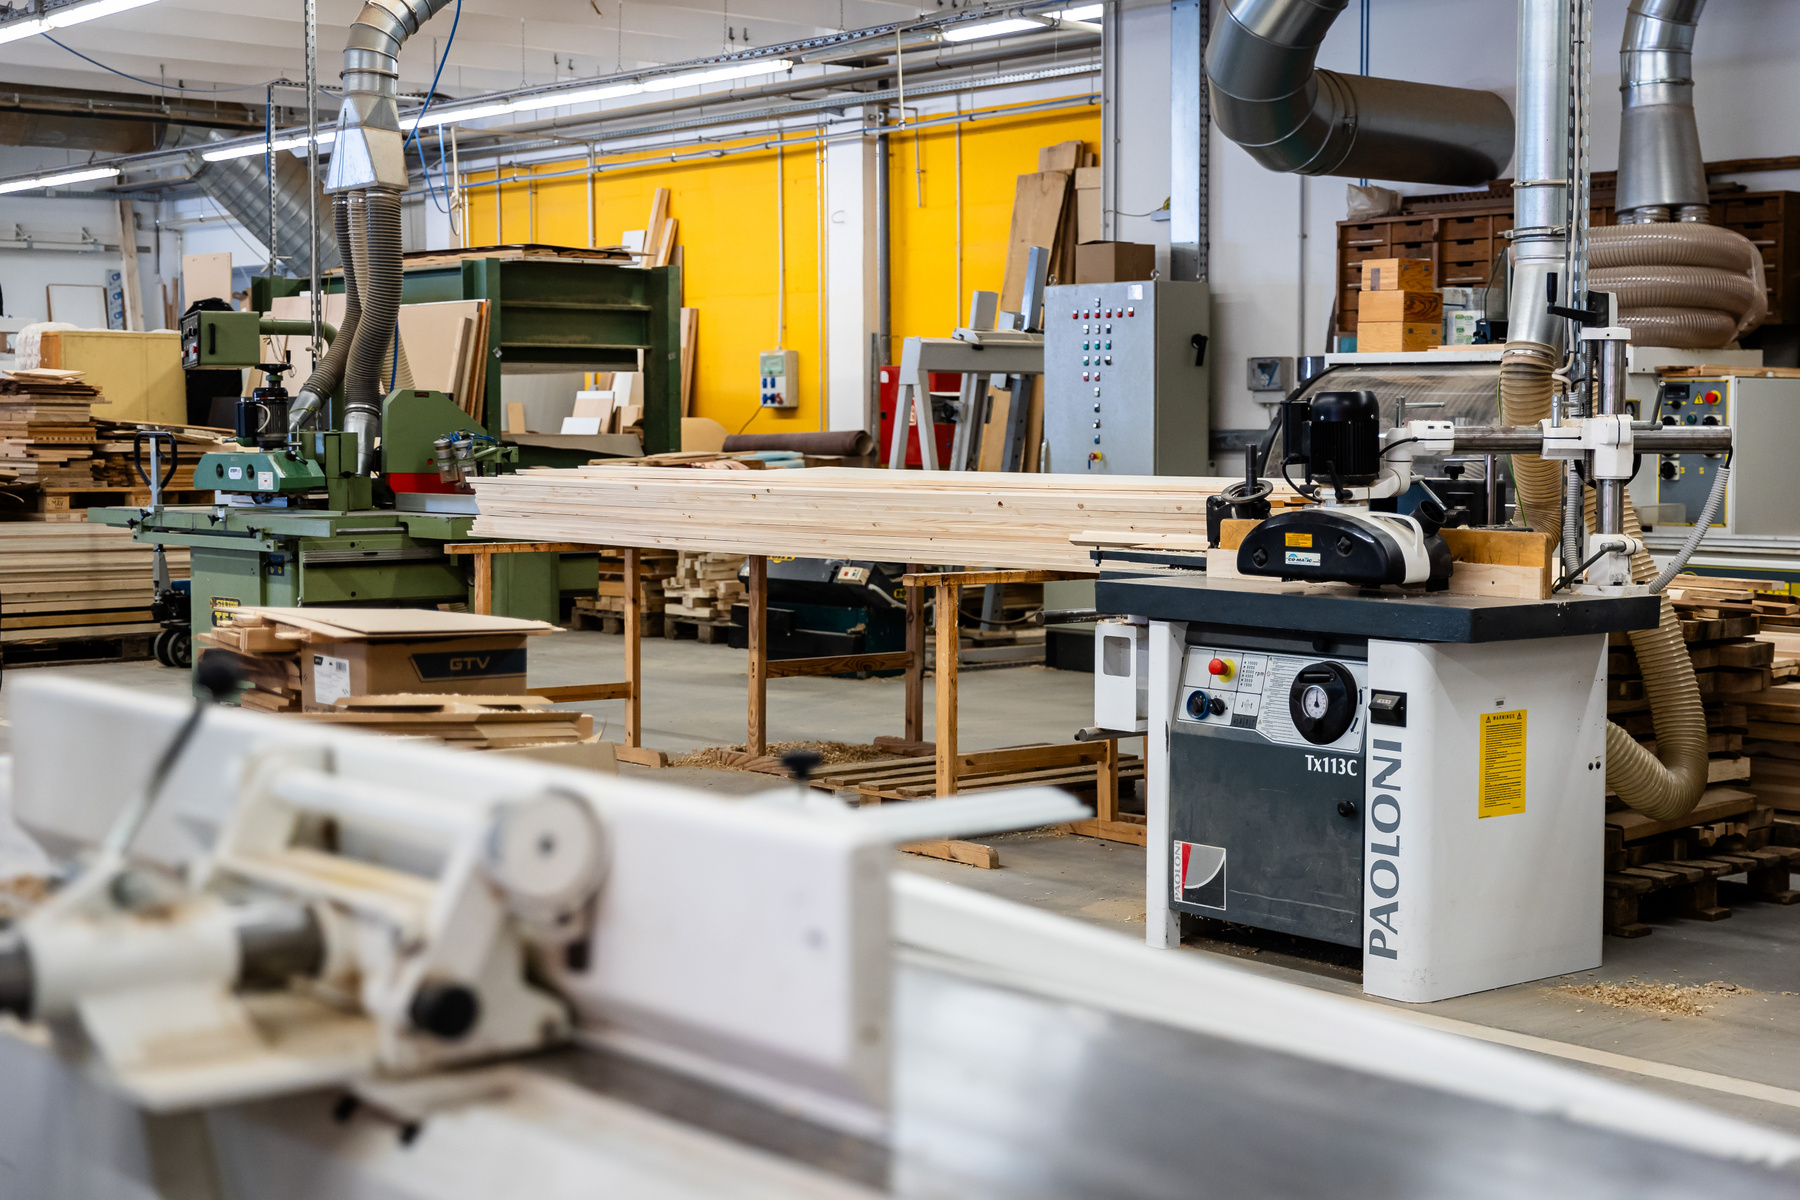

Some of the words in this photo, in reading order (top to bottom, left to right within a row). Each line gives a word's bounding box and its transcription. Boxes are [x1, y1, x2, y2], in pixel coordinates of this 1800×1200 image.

[450, 656, 490, 670] GTV
[1305, 754, 1358, 776] Tx113C
[1369, 738, 1402, 960] PAOLONI
